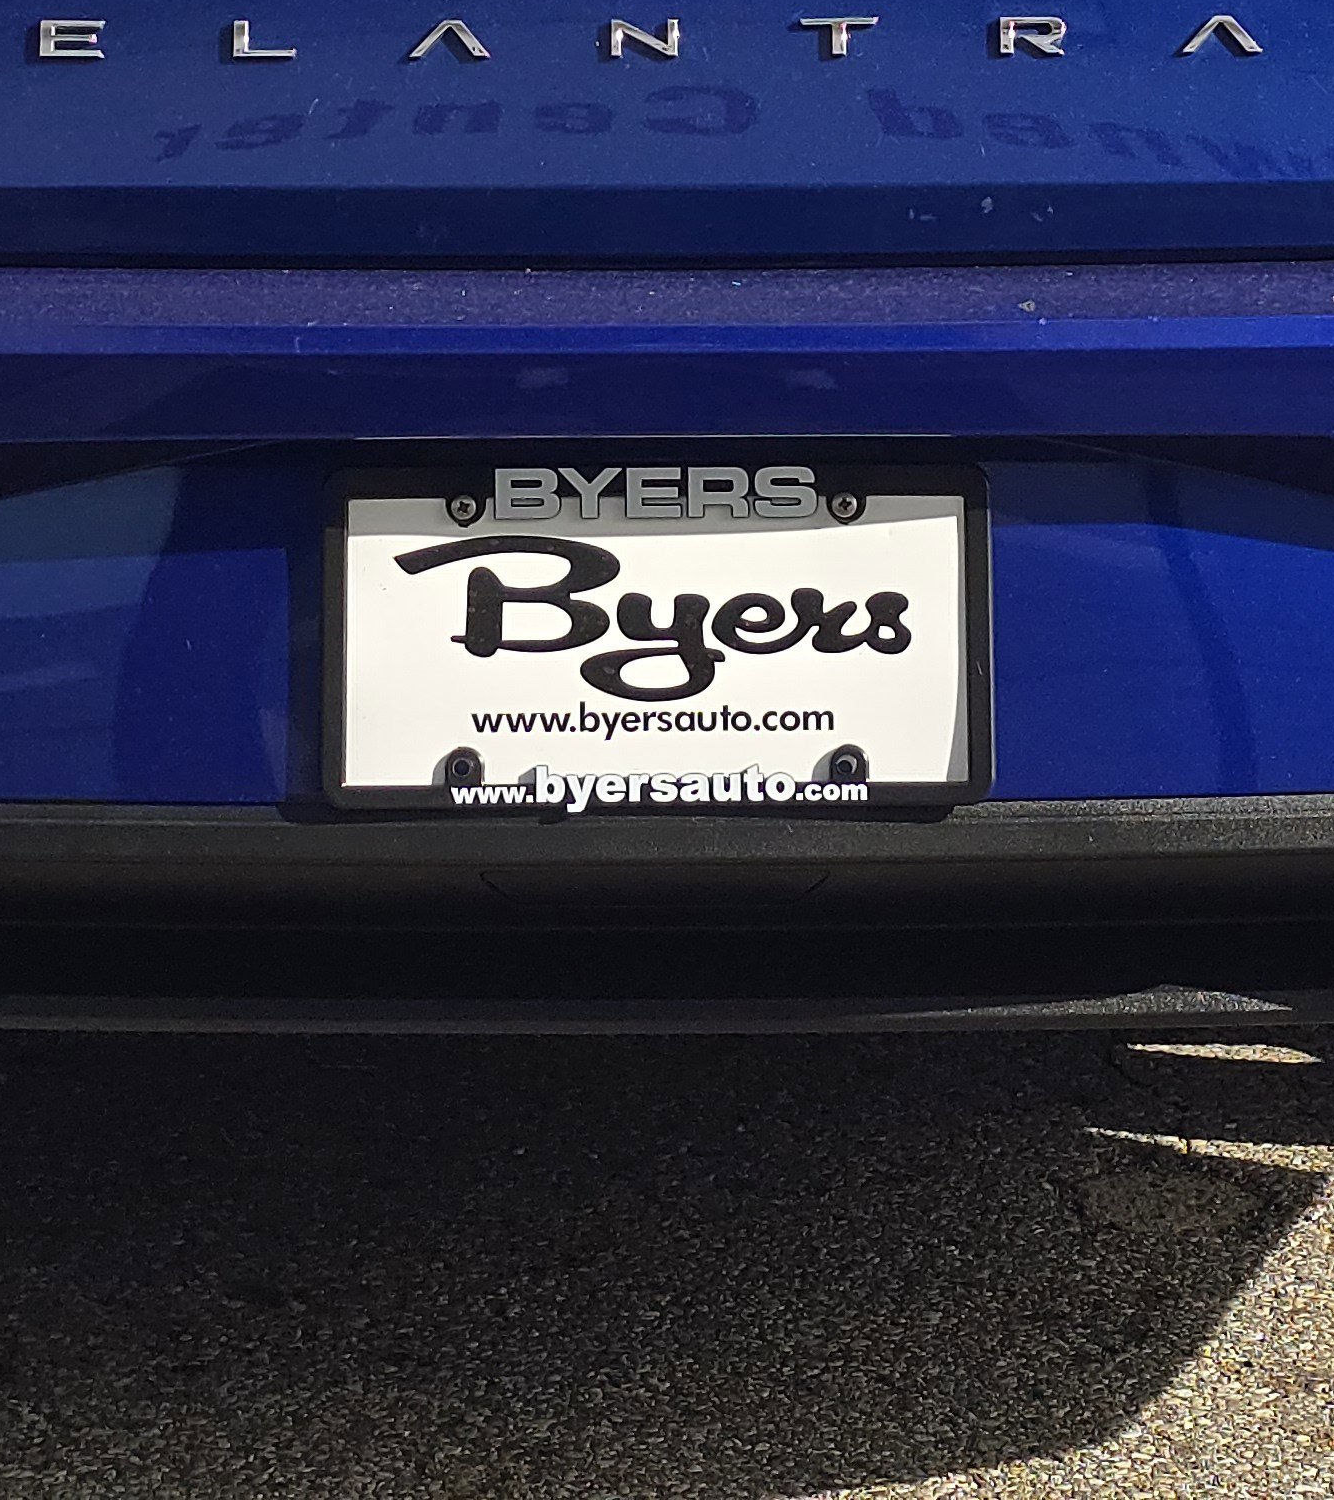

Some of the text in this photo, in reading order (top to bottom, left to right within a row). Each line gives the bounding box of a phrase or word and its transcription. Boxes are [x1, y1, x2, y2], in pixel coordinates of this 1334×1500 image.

[37, 15, 1264, 59] ELANTRA
[492, 466, 819, 520] BYERS
[394, 535, 912, 702] Byers
[471, 702, 835, 740] www.byersauto.com
[451, 765, 869, 813] www.byersauto.com
